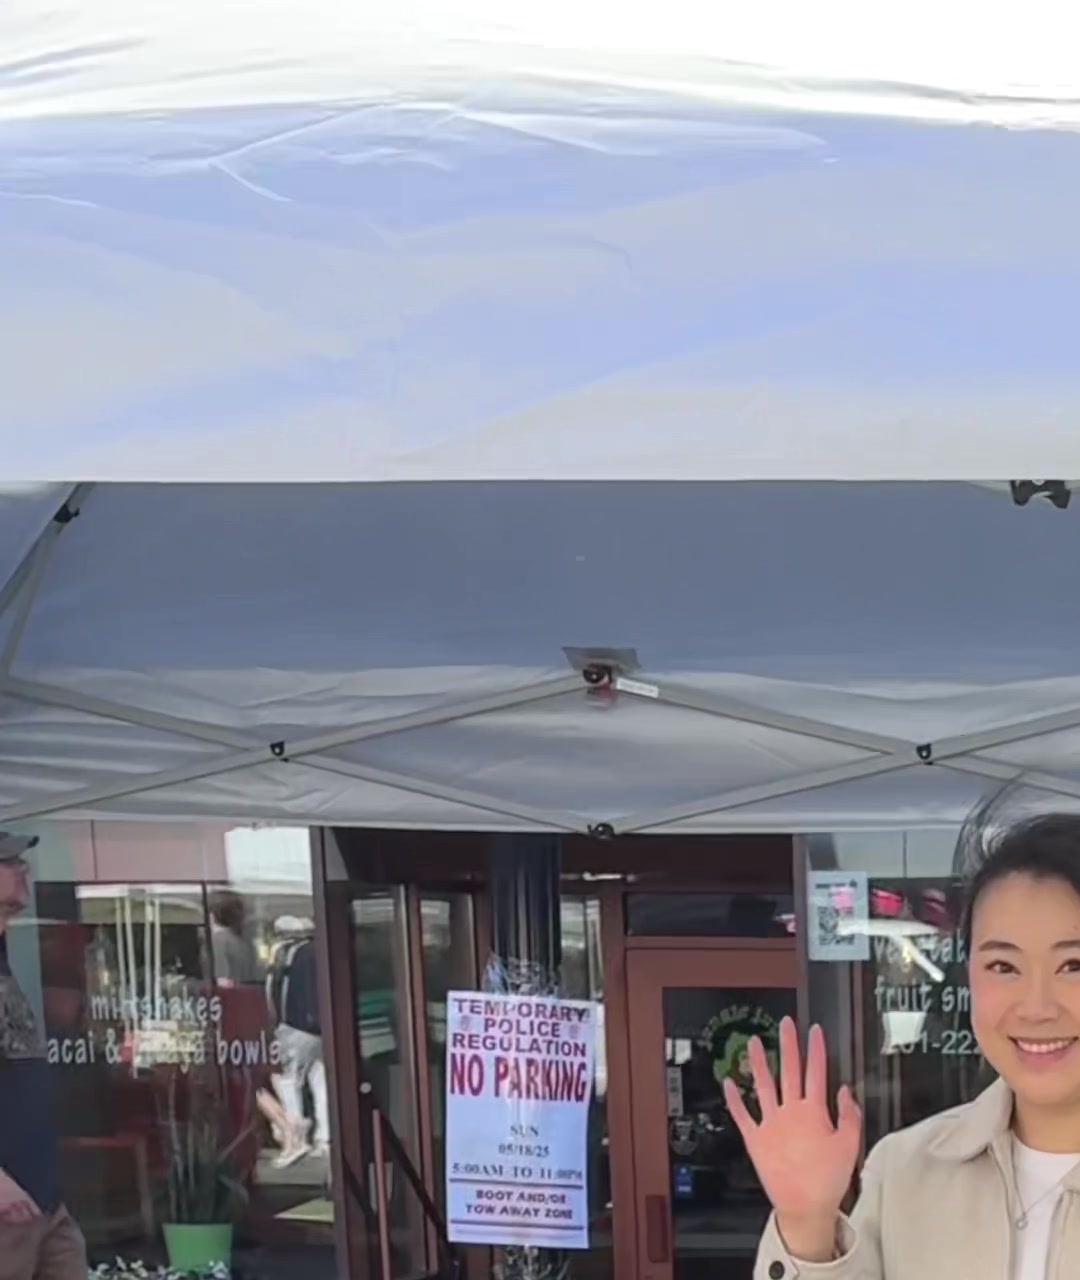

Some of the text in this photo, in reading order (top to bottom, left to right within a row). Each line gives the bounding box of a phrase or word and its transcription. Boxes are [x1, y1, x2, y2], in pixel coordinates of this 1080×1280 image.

[874, 974, 932, 1012] fruit
[452, 998, 588, 1022] TEMPORARY
[484, 1017, 562, 1038] POLICE
[48, 1029, 96, 1064] acai
[105, 1028, 121, 1064] &
[217, 1028, 284, 1066] bowls
[452, 1032, 587, 1058] REGULATION
[450, 1052, 587, 1103] NO PARKING
[509, 1124, 540, 1138] SUN
[512, 1165, 533, 1179] TO
[475, 1189, 514, 1201] BOOT
[465, 1204, 496, 1215] TOW
[499, 1206, 541, 1218] AWAY
